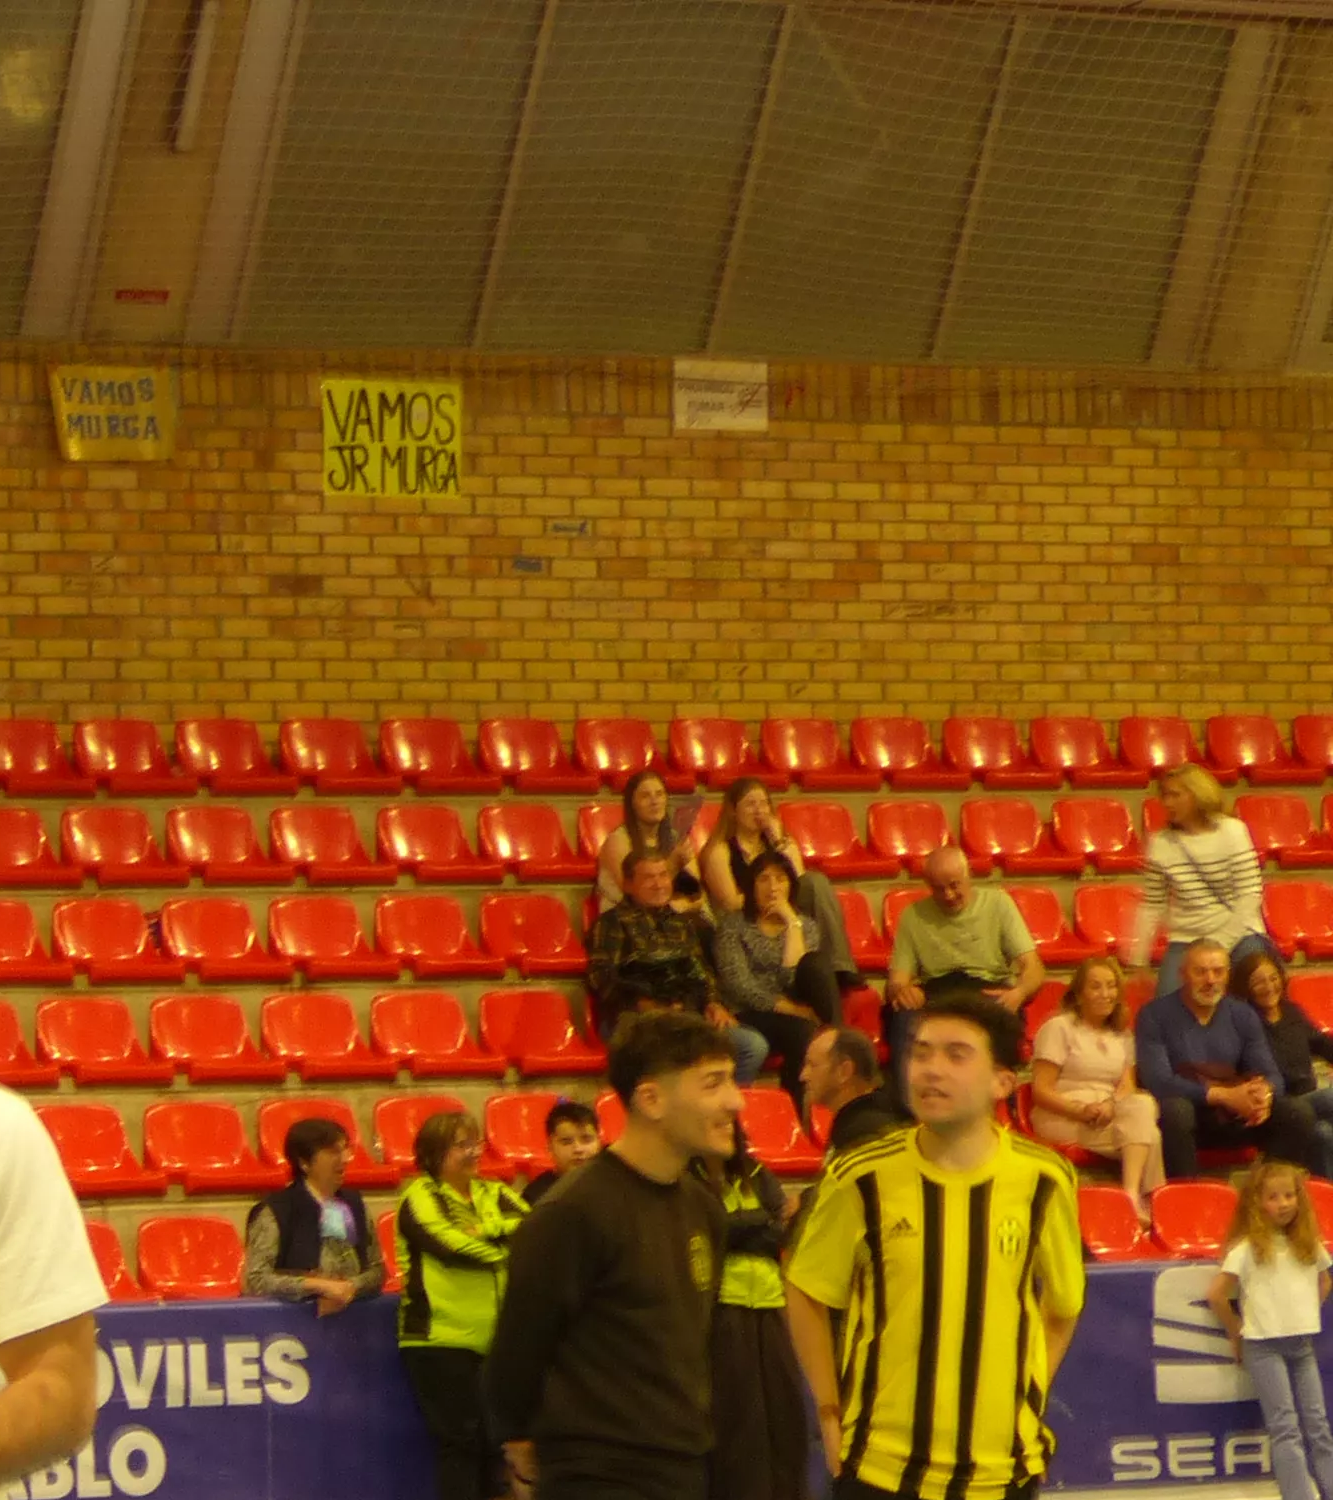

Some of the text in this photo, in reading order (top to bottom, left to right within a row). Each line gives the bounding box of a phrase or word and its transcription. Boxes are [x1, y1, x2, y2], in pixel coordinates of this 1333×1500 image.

[62, 376, 155, 406] VAMOS
[326, 387, 456, 445] VAMOS
[328, 444, 461, 494] JR. MURGA
[1111, 1435, 1272, 1482] SEA
